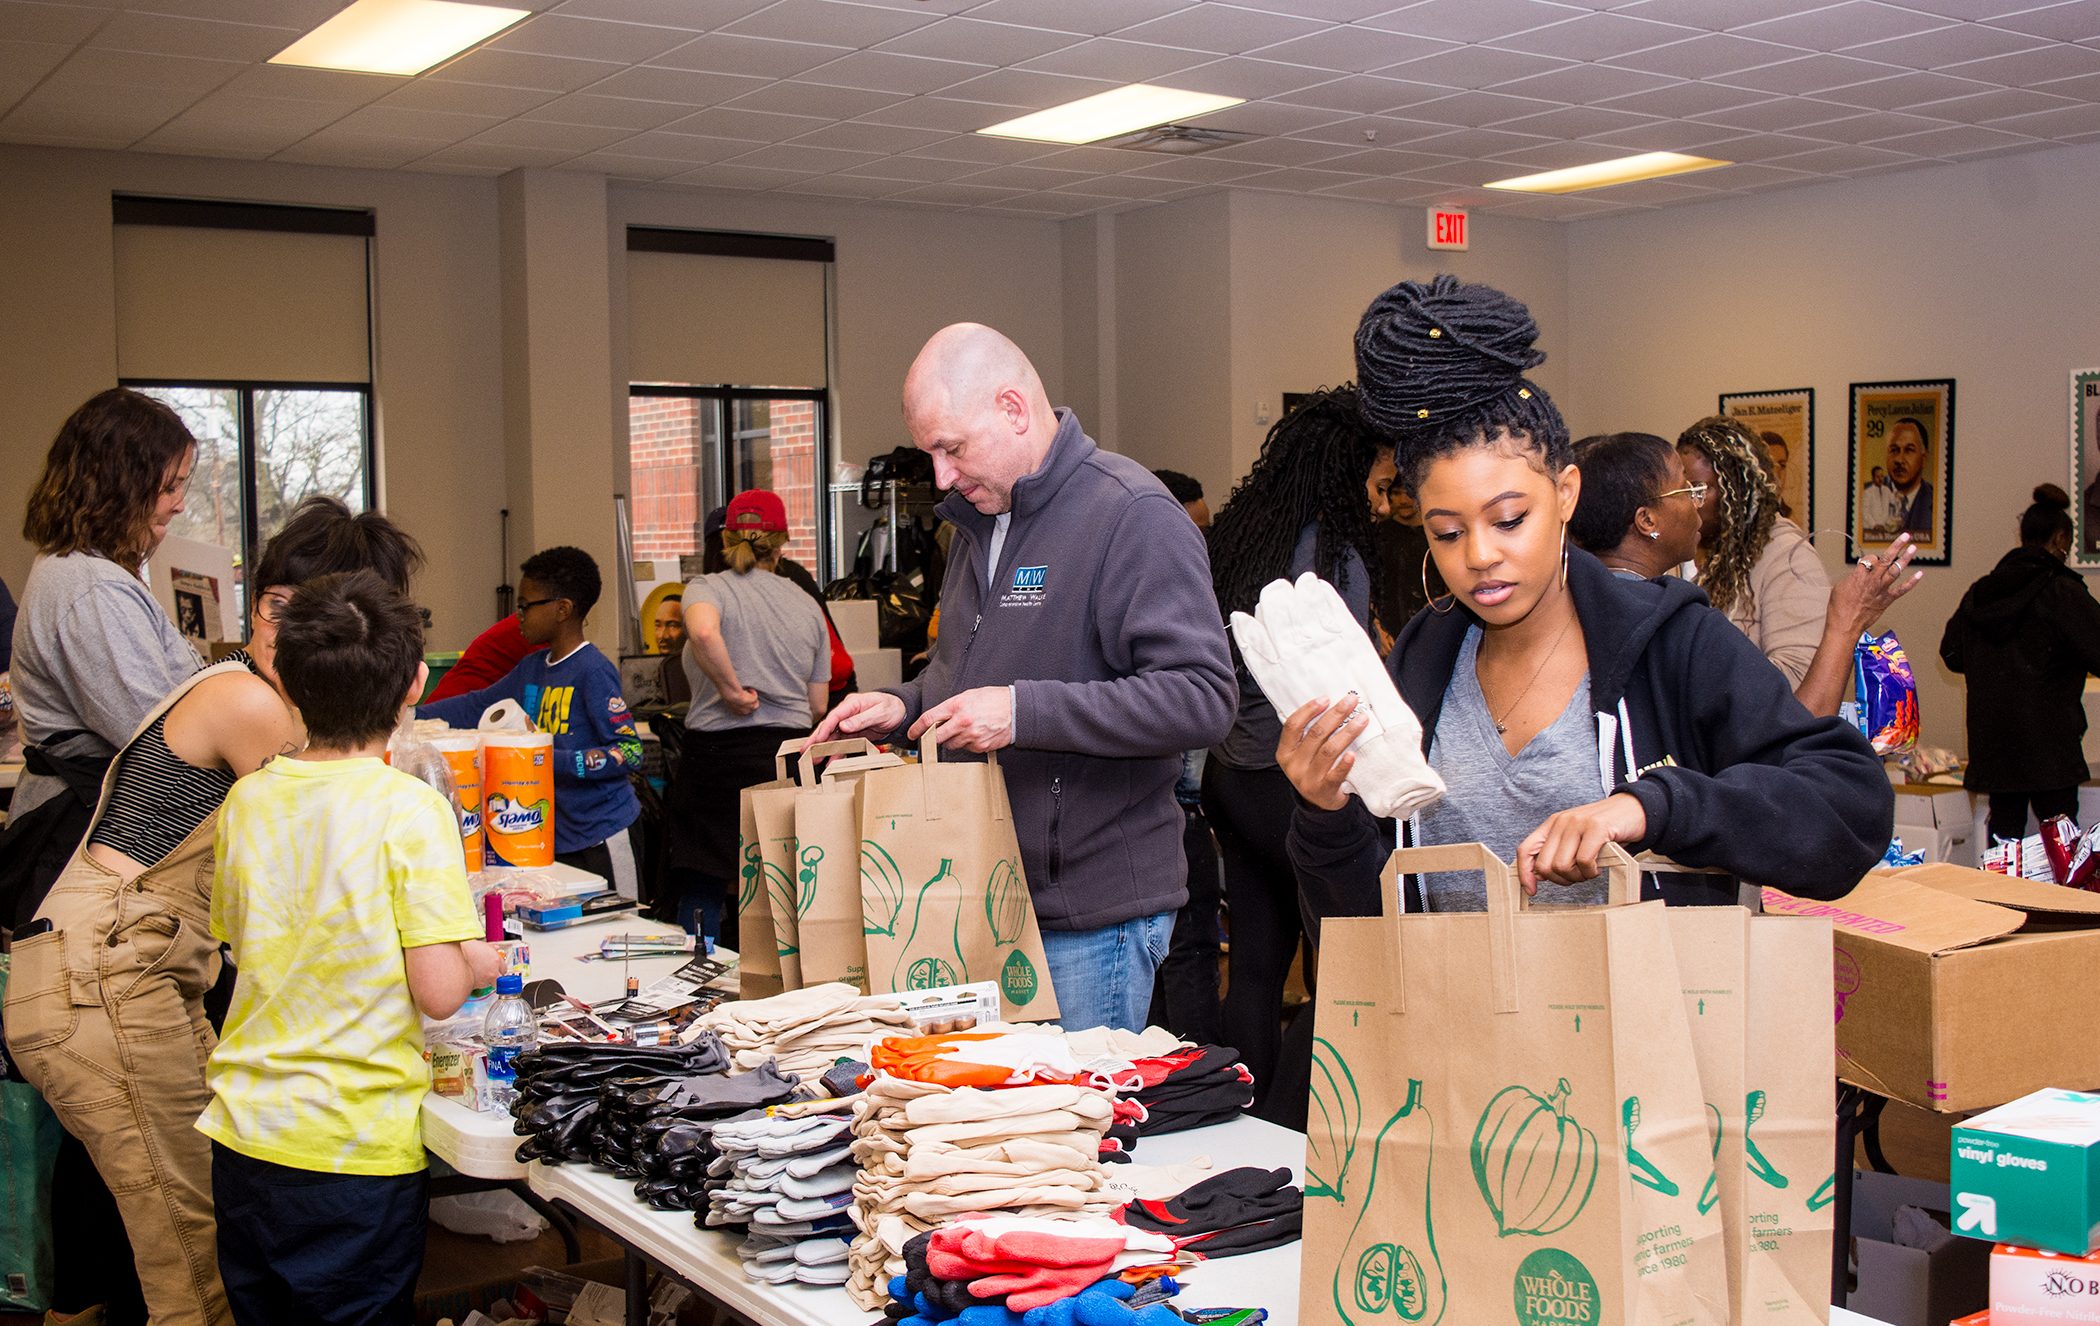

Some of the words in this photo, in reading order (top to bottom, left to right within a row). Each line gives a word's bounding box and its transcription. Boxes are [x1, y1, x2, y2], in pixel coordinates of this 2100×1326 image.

[1436, 212, 1465, 244] EXIT
[1867, 420, 1884, 437] 29
[1016, 570, 1046, 585] MW
[499, 806, 545, 829] Towels
[1797, 905, 1906, 934] ORIENTED
[1007, 966, 1031, 977] WHOLE
[1008, 977, 1033, 988] FOODS
[432, 1052, 460, 1071] Energizer
[1958, 1136, 1999, 1148] powder-free
[1957, 1146, 1994, 1165] vinyl
[1996, 1152, 2047, 1171] gloves
[1752, 1227, 1793, 1238] farmers
[1653, 1237, 1694, 1255] farmers
[1520, 1274, 1592, 1301] WHOLE
[1525, 1296, 1591, 1321] FOODS
